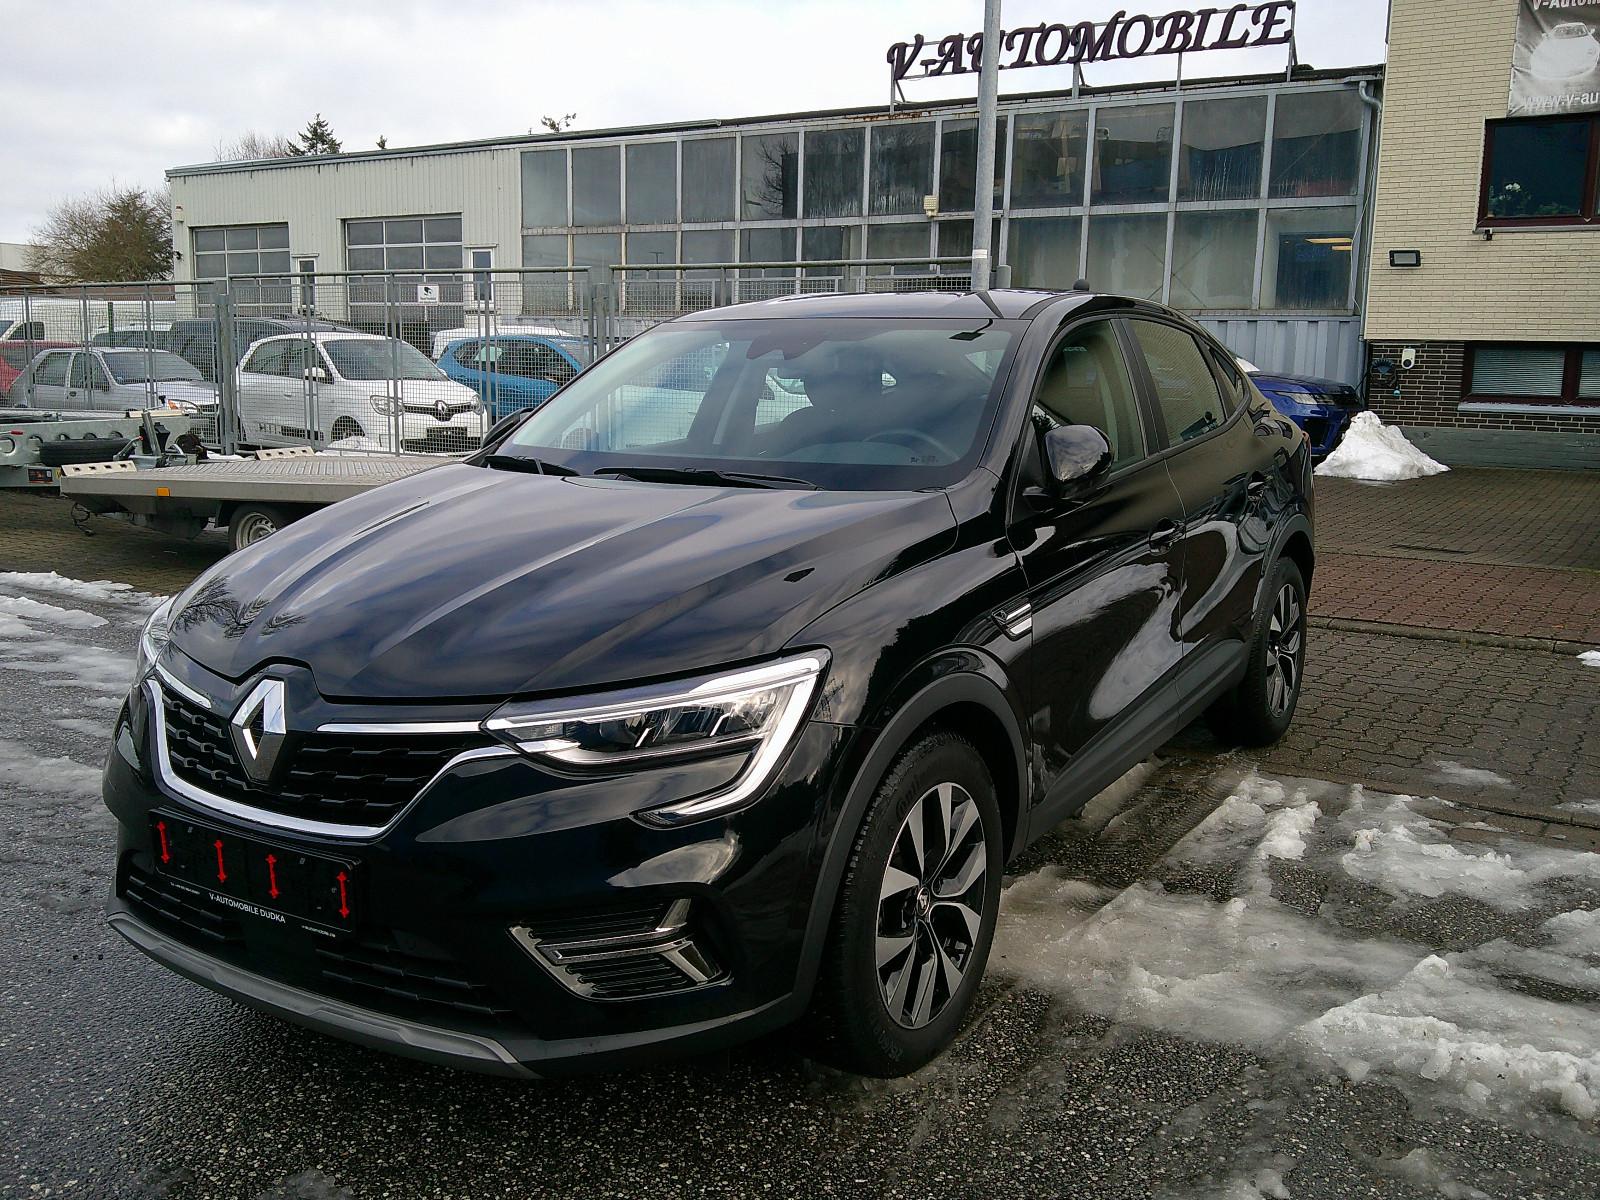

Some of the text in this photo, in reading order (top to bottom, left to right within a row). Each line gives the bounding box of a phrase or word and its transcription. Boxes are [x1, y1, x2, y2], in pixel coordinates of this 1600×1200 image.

[887, 1, 1296, 80] V-AUTOMOBILE
[208, 892, 286, 925] V-AUTOMOBILE DUDKA
